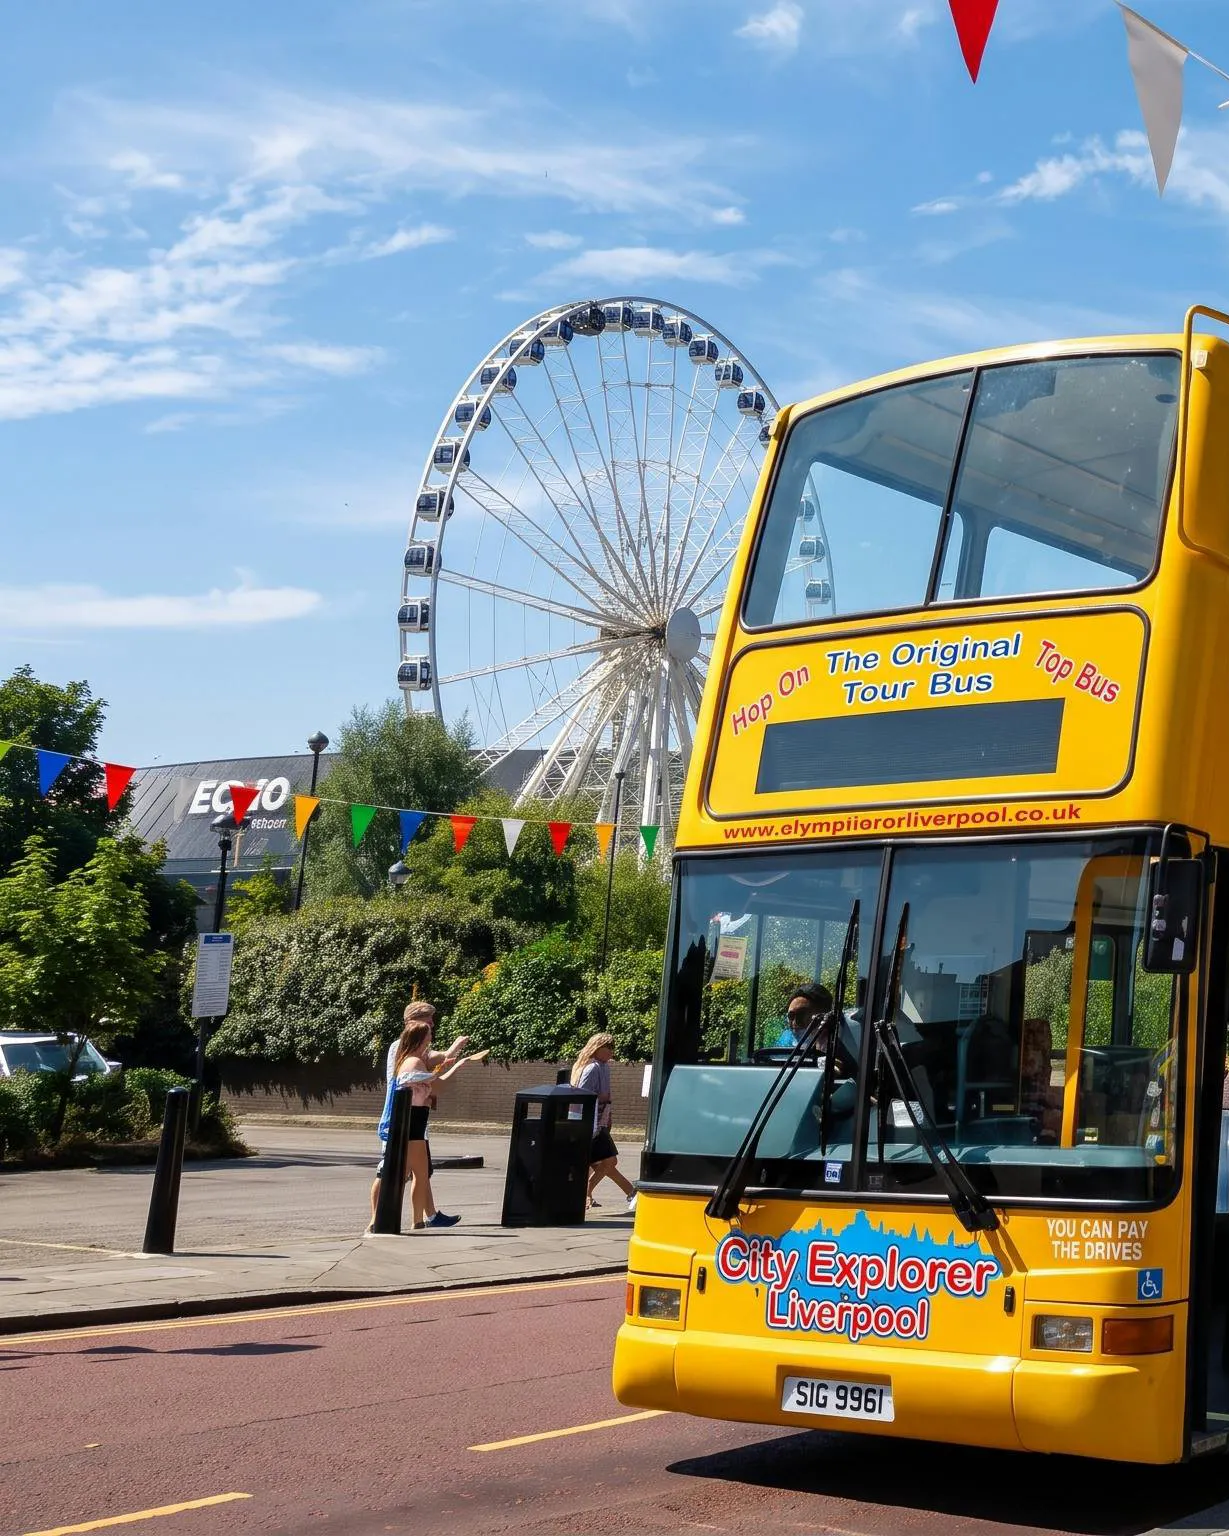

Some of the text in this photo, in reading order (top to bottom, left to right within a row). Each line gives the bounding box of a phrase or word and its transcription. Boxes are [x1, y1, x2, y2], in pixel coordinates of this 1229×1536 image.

[826, 633, 1020, 674] The Original
[1035, 639, 1120, 704] Top Bus
[730, 665, 809, 736] Hop On
[843, 672, 993, 704] Tour Bus
[1047, 1219, 1148, 1239] YOU CAN PAY
[718, 1236, 999, 1299] City Explorer
[1051, 1240, 1143, 1261] THE DRIVES
[767, 1289, 929, 1342] Liverpool
[796, 1381, 884, 1414] SIG 9961
